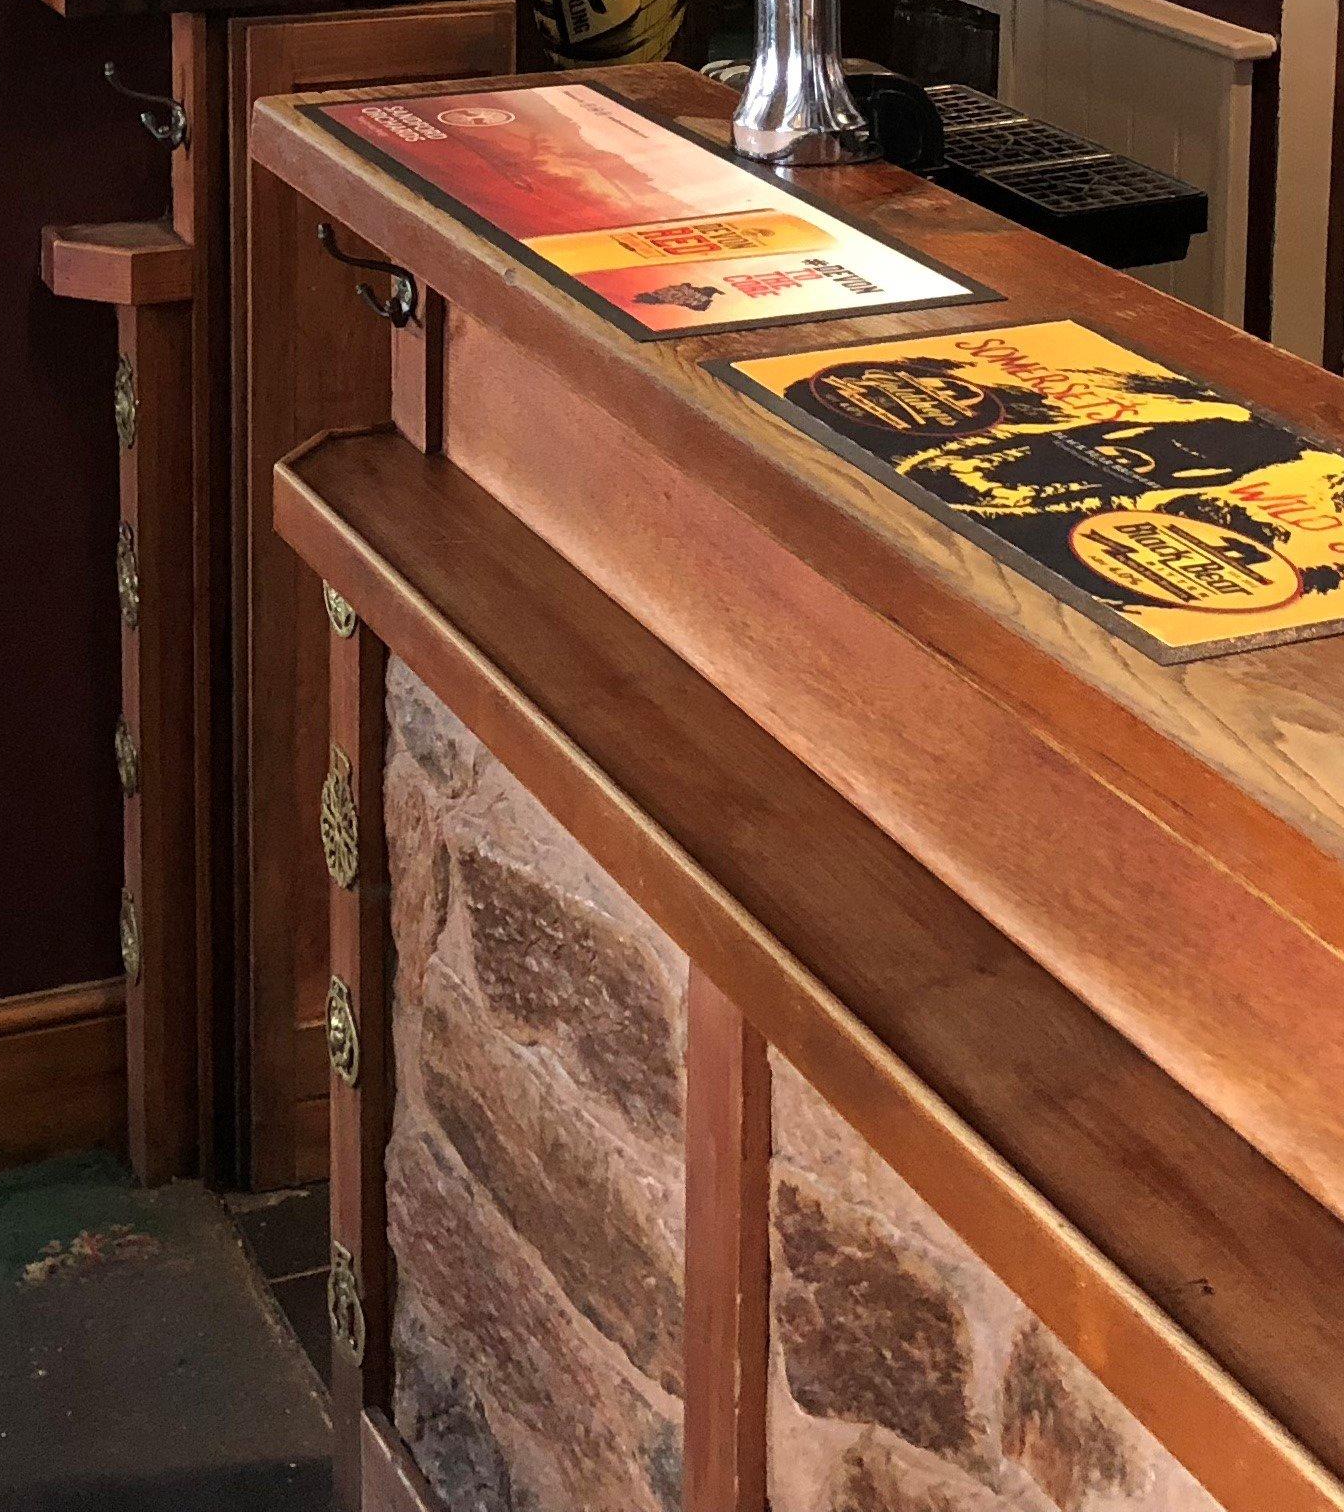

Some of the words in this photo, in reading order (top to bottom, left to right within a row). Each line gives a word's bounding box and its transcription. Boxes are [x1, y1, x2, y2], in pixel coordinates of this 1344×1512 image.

[380, 105, 452, 139] SANDFORD
[632, 226, 726, 255] RED
[688, 222, 762, 249] DEVON
[717, 274, 781, 298] CORE
[749, 271, 804, 289] THE
[779, 268, 825, 281] TO
[795, 257, 887, 294] #DEVON
[955, 338, 1147, 423] SOMERSET'S
[1229, 482, 1343, 531] WILD
[1114, 521, 1194, 561] Black
[1180, 558, 1254, 596] Bear
